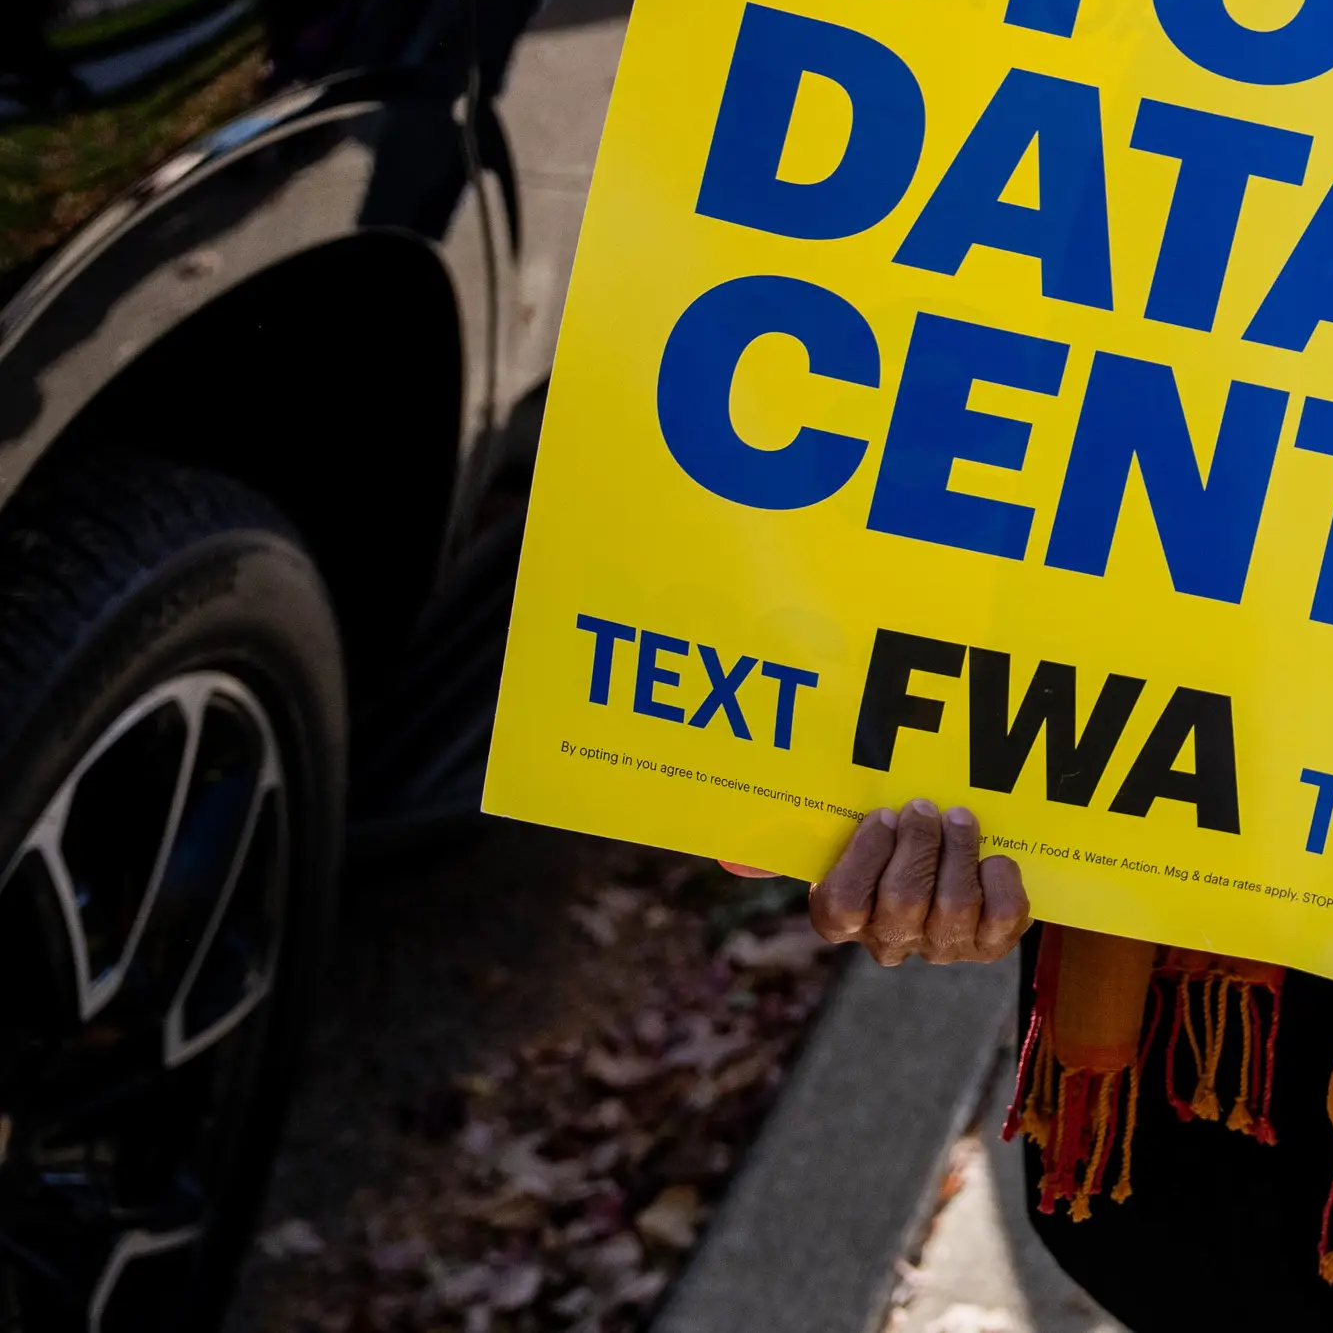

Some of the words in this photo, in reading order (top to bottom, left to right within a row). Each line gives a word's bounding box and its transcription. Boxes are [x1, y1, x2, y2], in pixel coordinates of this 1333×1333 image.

[576, 614, 819, 750] TEXT
[852, 628, 1240, 835] FWA
[561, 741, 576, 756] By
[580, 747, 618, 764] opting
[622, 753, 633, 765] in
[636, 759, 657, 770] you
[660, 764, 693, 779] agree
[696, 771, 707, 782] to
[710, 775, 750, 792] receive
[753, 785, 801, 807] recurring
[804, 797, 824, 811] text
[992, 835, 1028, 851] Watch
[1030, 842, 1038, 854] /
[1040, 843, 1070, 858] Food
[1073, 849, 1081, 860] &
[1085, 851, 1118, 867] Water
[1120, 858, 1161, 875] Action.
[1164, 865, 1189, 881] Msg
[1192, 870, 1200, 881] &
[1204, 872, 1230, 887] data
[1233, 879, 1261, 893] rates
[1264, 885, 1299, 902] apply.
[1302, 892, 1333, 908] STOP
